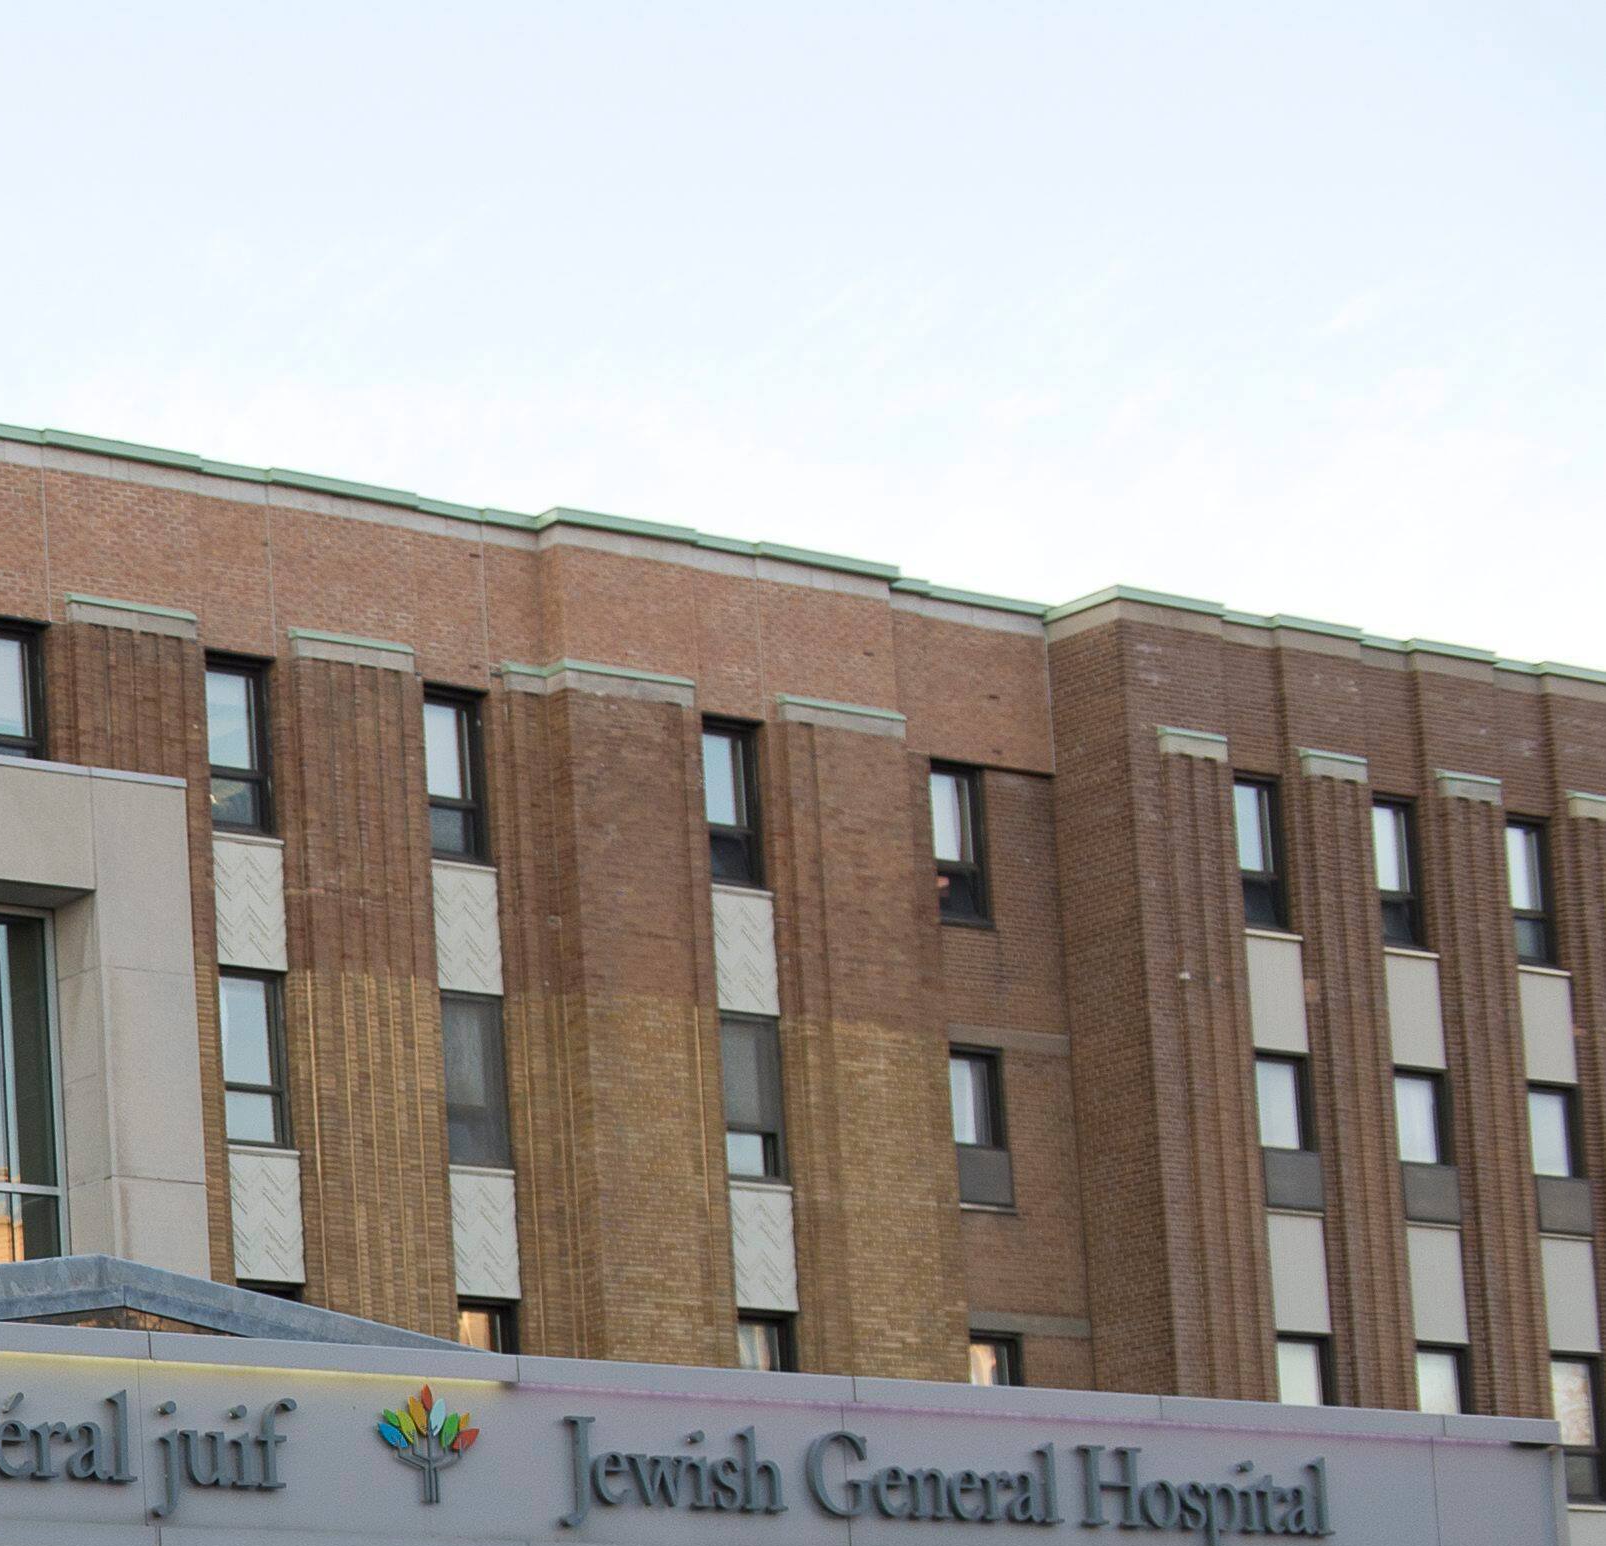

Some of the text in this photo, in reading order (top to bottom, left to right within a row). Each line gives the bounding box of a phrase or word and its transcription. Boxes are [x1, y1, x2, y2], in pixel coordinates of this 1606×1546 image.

[150, 1396, 298, 1518] juif
[556, 1414, 789, 1528] Jewish
[805, 1429, 1066, 1527] General
